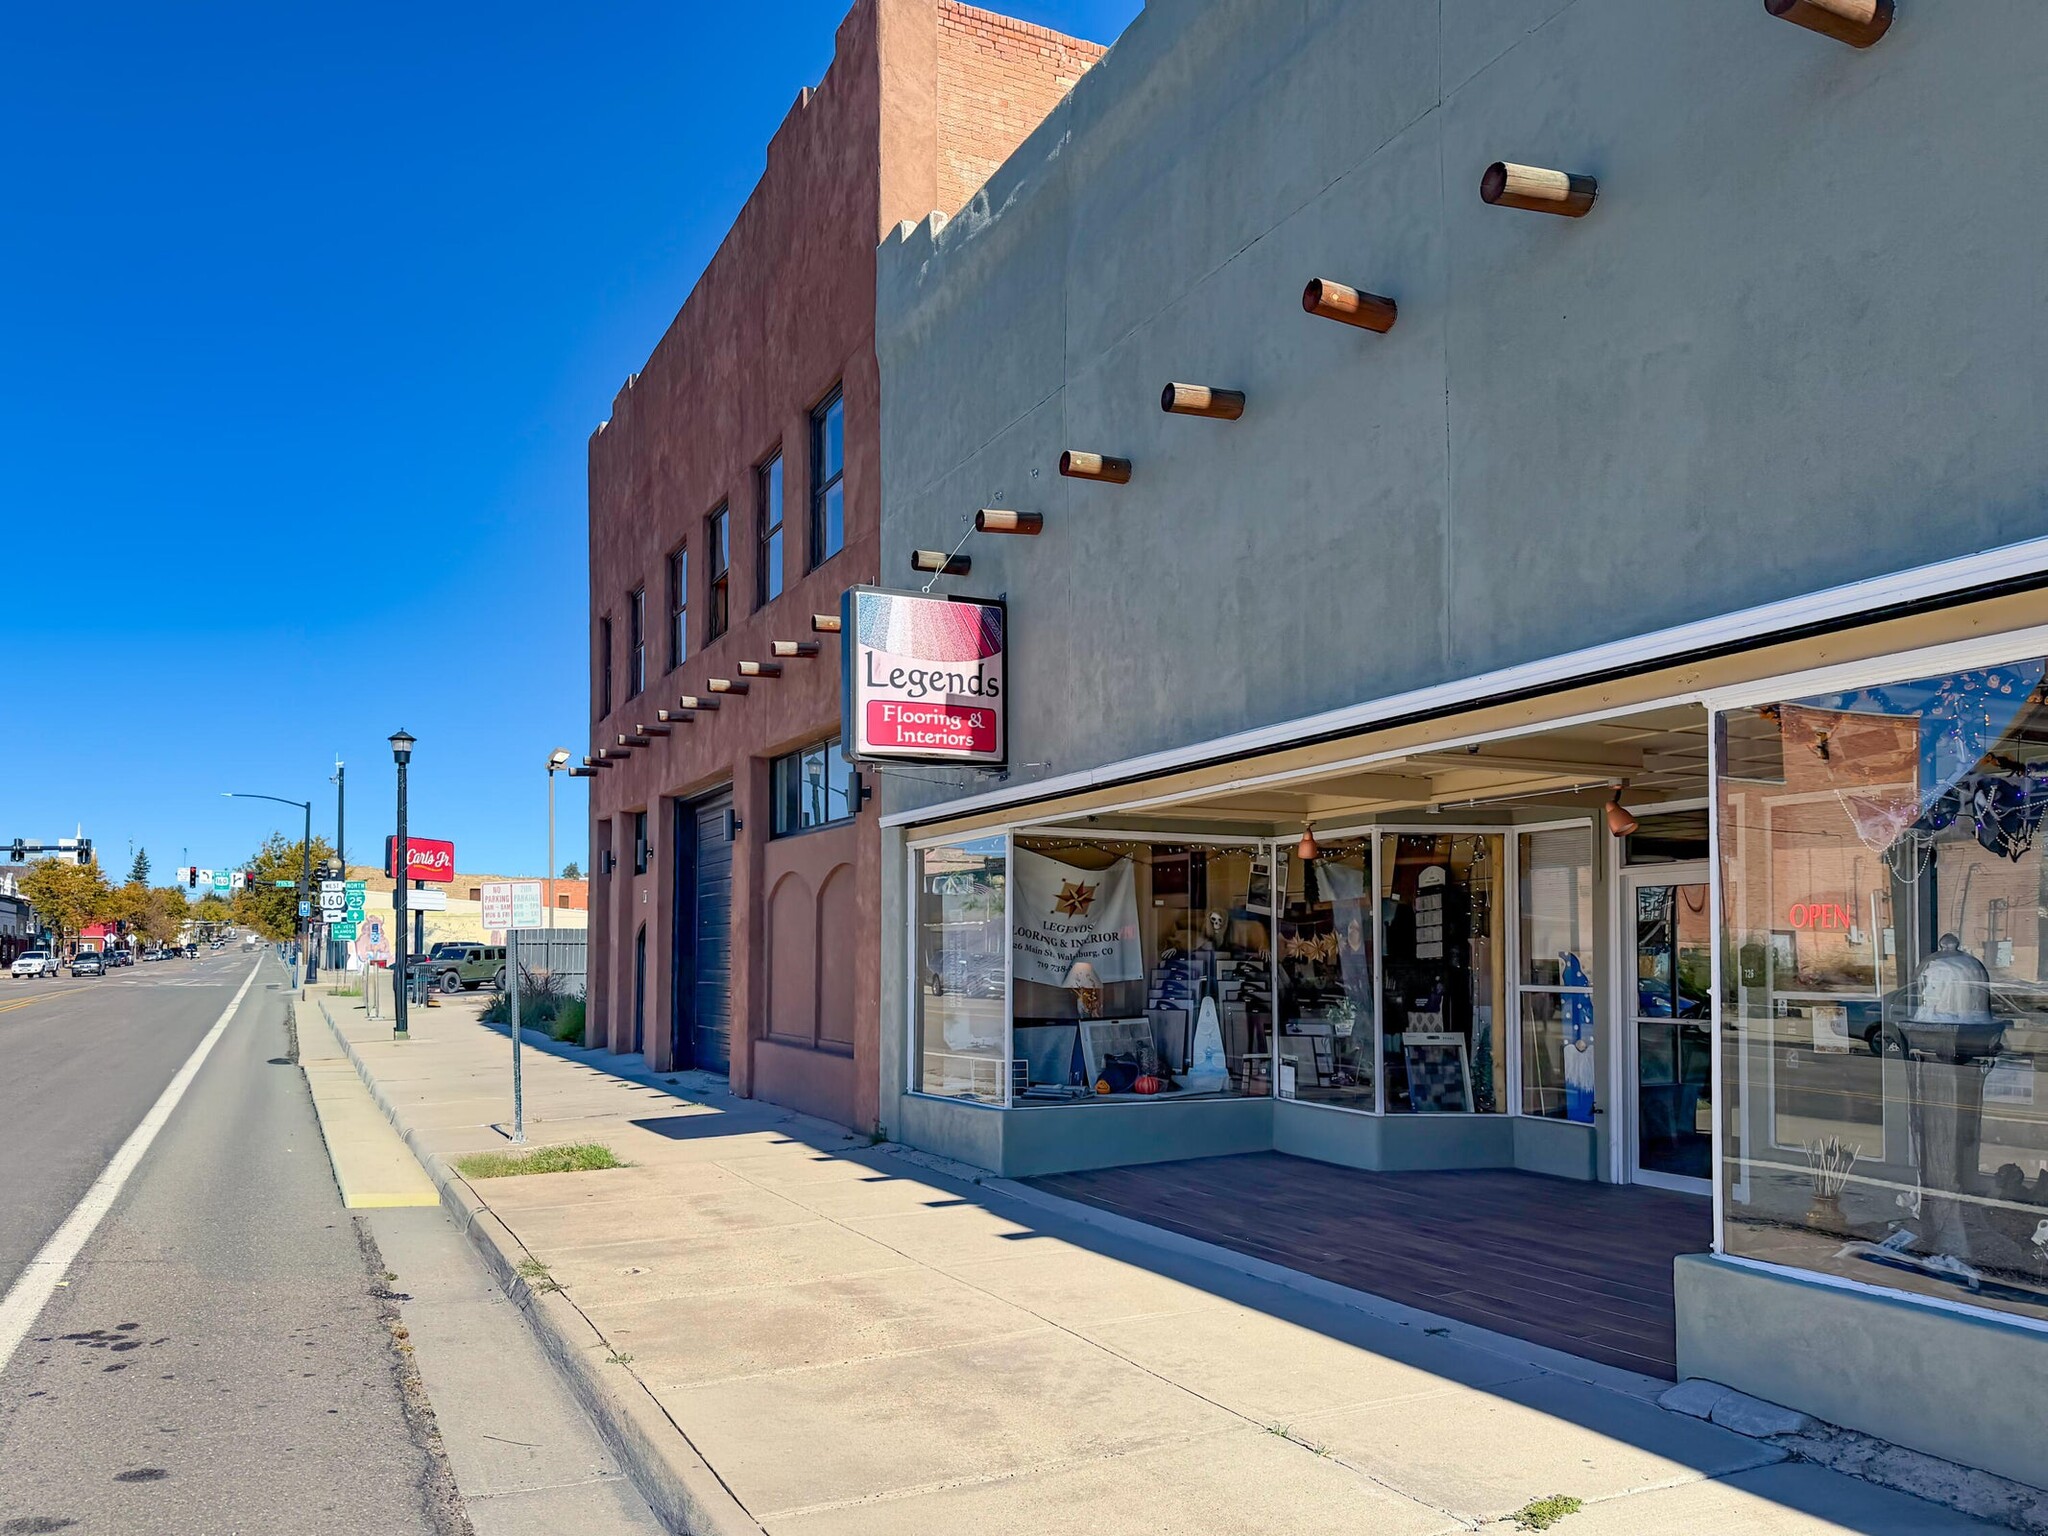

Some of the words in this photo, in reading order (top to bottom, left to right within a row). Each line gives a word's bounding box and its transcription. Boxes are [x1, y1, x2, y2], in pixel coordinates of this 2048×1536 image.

[865, 651, 999, 698] Legends
[882, 704, 961, 730] Flooring
[967, 712, 985, 729] &
[896, 725, 975, 747] Interiors
[407, 848, 435, 865] Carl's
[322, 895, 343, 906] 160
[349, 896, 363, 906] 25
[485, 894, 510, 903] PARKING
[513, 894, 539, 902] PARKING
[1790, 903, 1851, 929] OPEN
[1043, 920, 1094, 934] LEGENDS
[1013, 925, 1058, 947] LOORING
[1060, 940, 1068, 948] &
[1013, 942, 1023, 950] 26
[1024, 944, 1043, 955] Main
[1101, 947, 1114, 956] CO
[1037, 961, 1049, 970] 719
